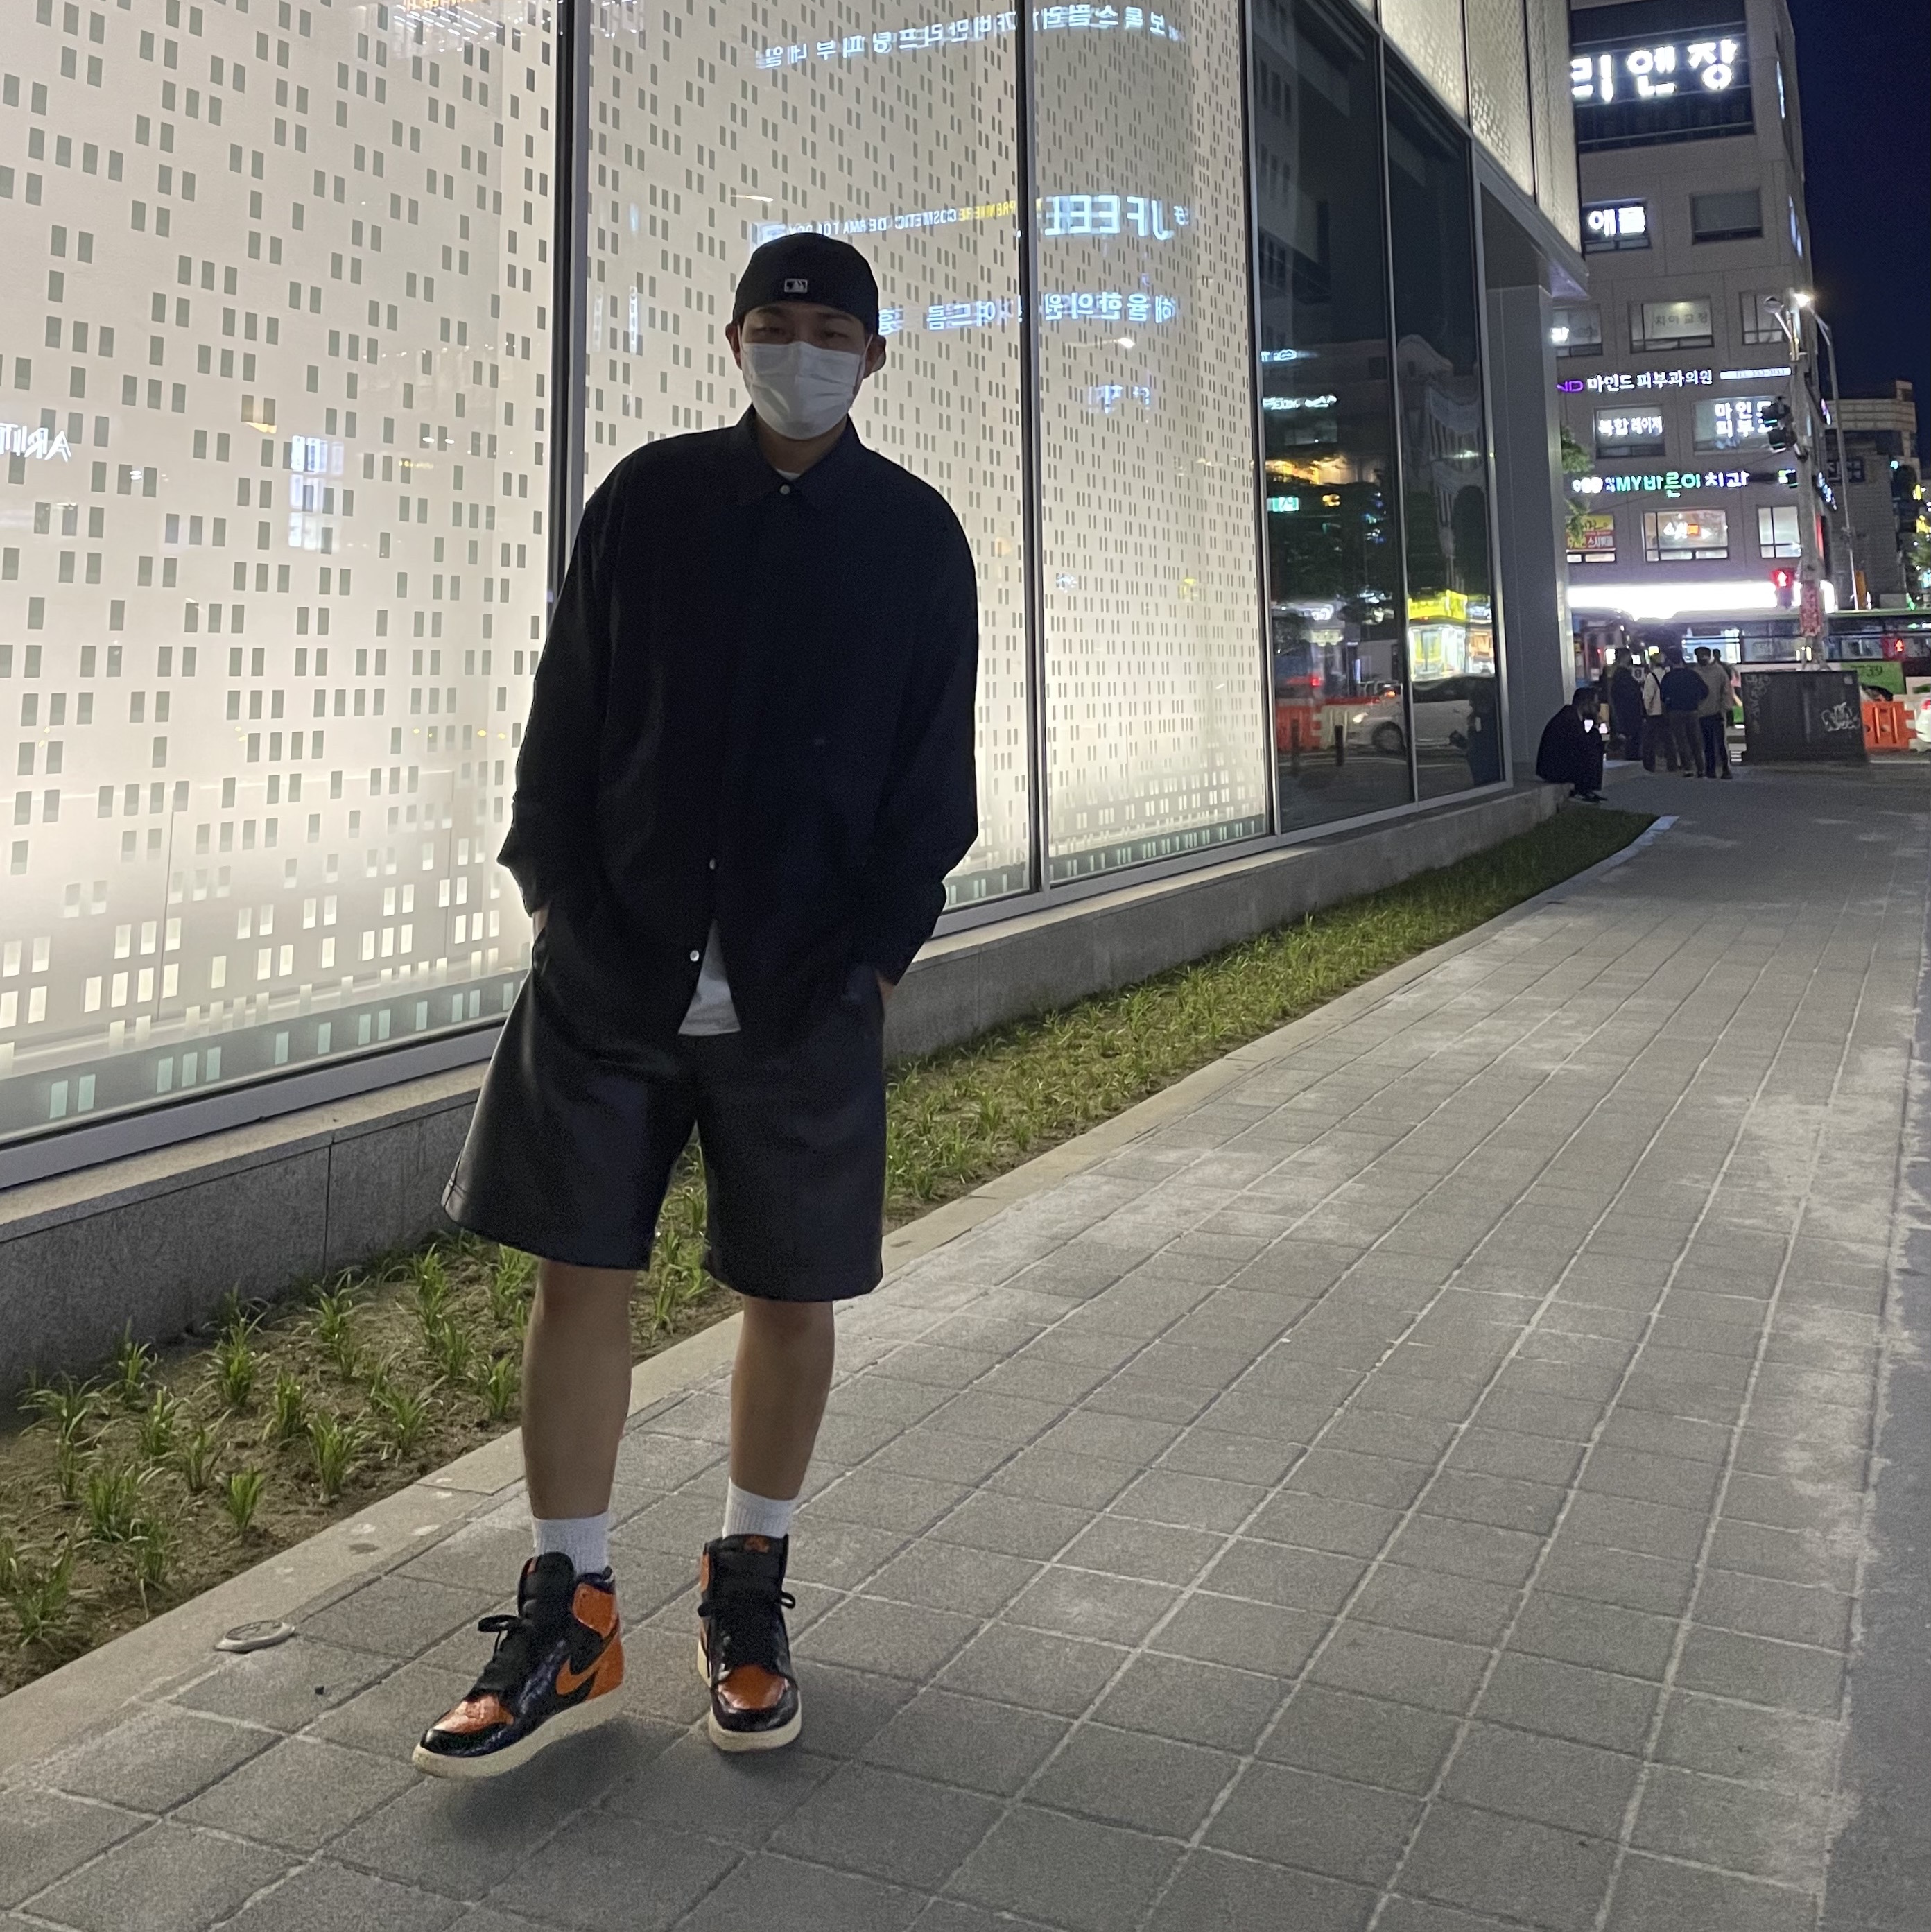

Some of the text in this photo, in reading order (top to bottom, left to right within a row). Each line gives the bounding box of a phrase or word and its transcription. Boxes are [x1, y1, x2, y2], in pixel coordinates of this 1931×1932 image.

[1586, 369, 1713, 393] 마인드 피부과의원
[1704, 470, 1749, 488] 치과
